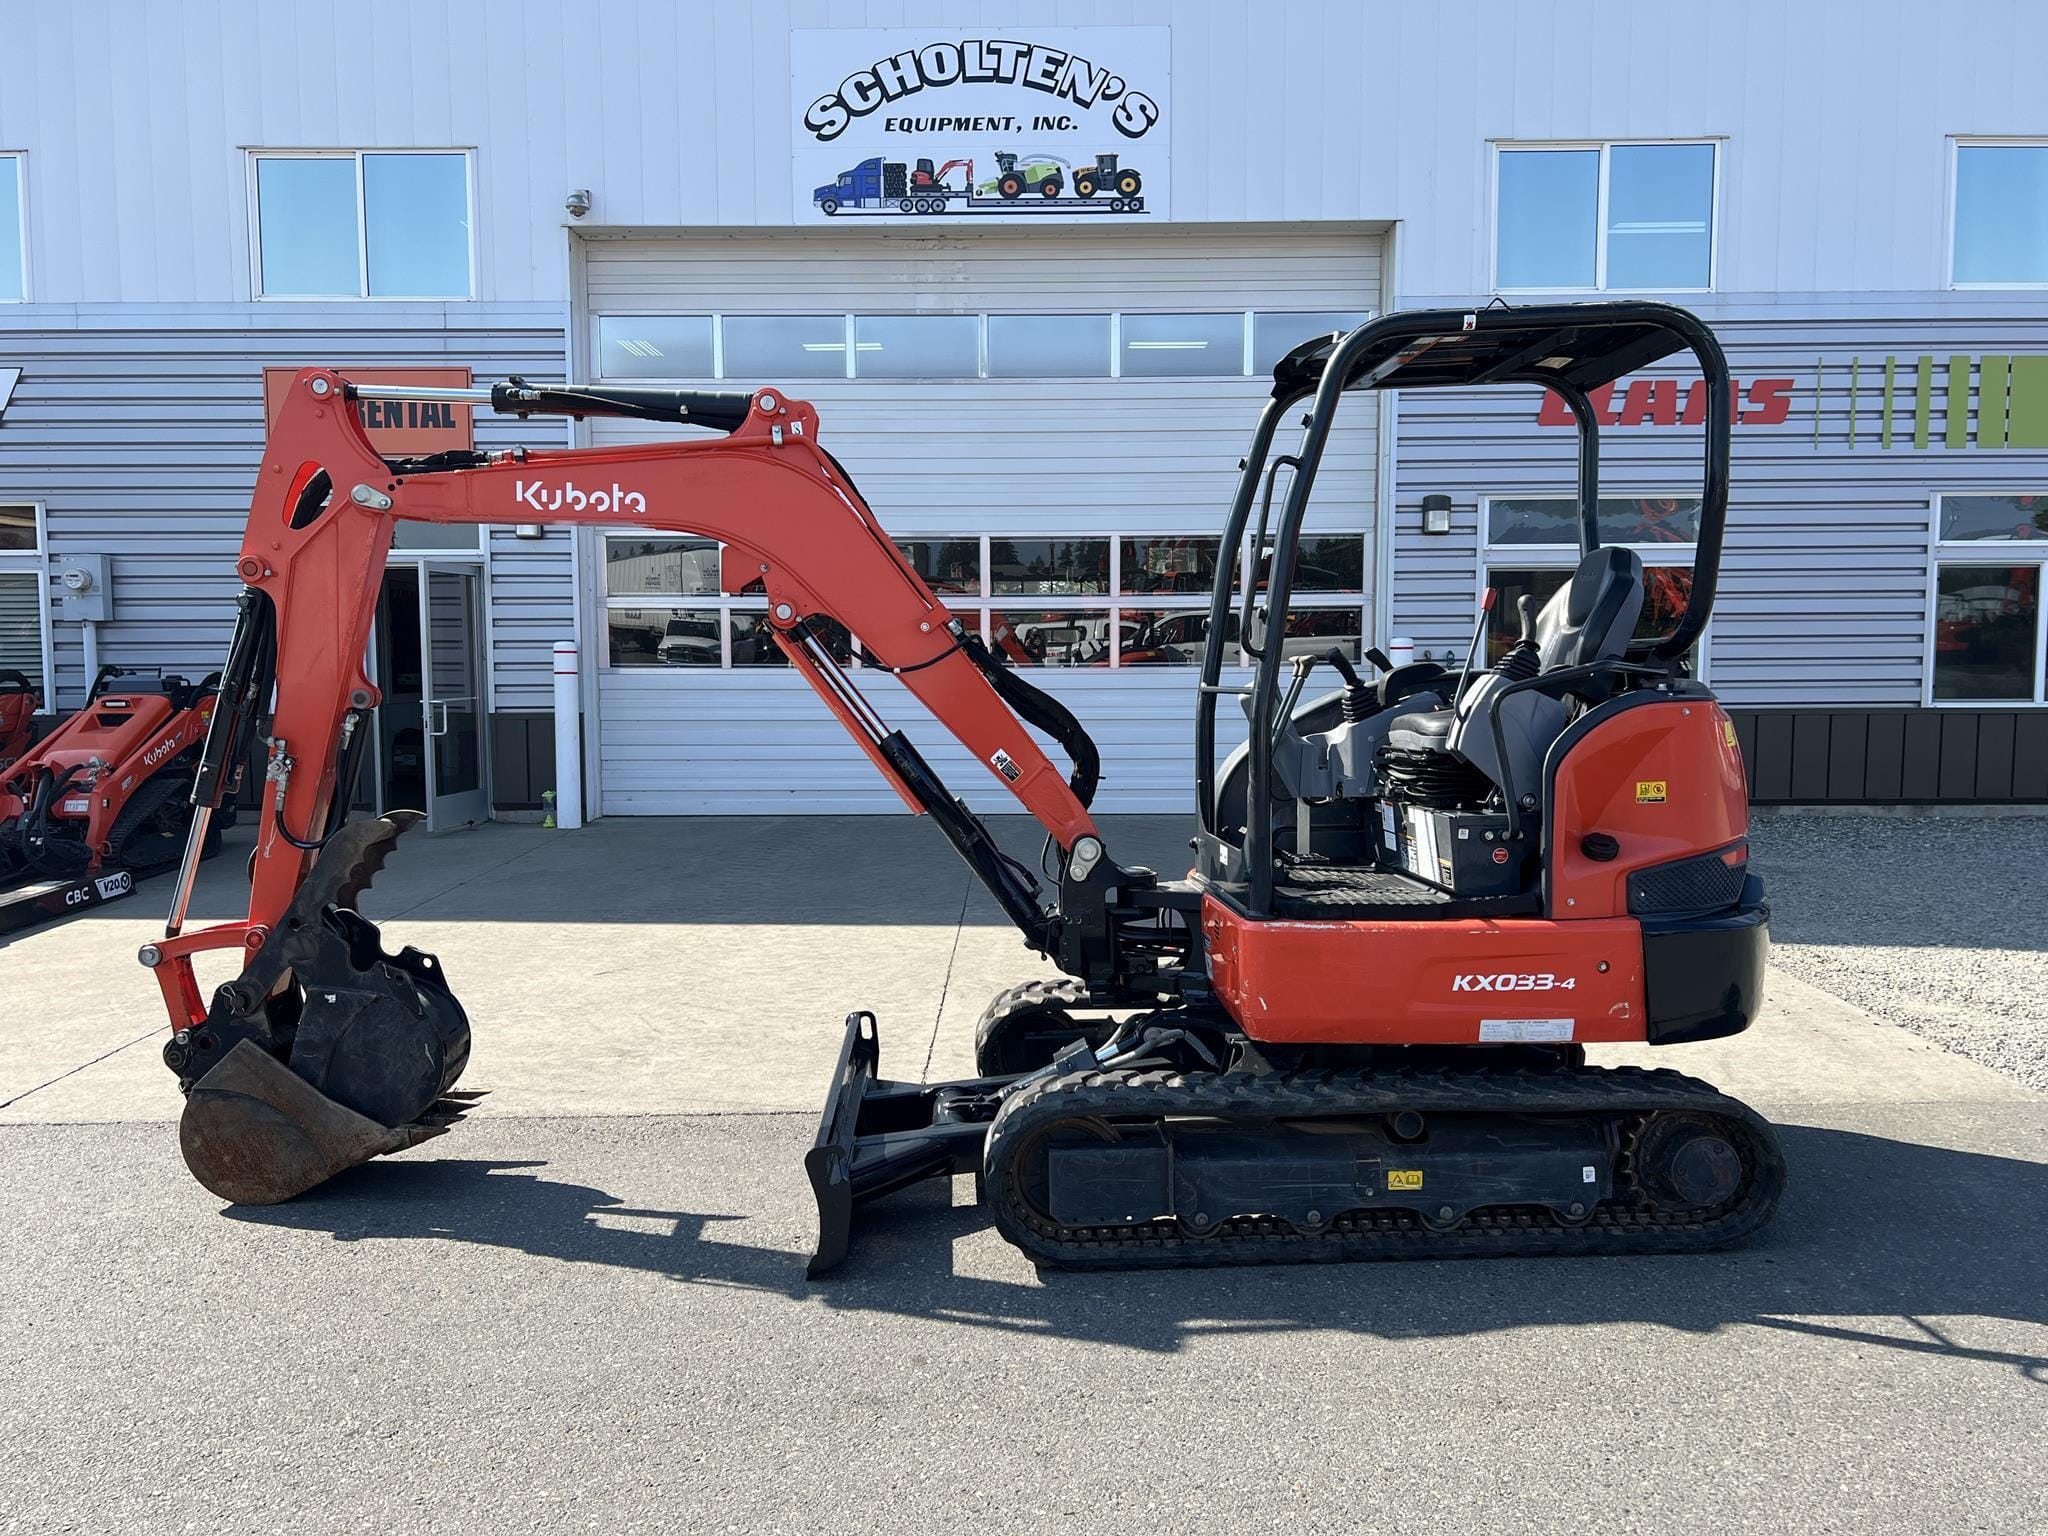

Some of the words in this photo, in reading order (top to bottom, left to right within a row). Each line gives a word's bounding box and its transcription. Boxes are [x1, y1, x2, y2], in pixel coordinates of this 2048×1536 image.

[804, 40, 1159, 141] SCHOLTEN'S
[884, 116, 1023, 133] EQUIPMENT,
[1032, 116, 1079, 131] INC.
[516, 480, 646, 512] Kubota
[143, 739, 175, 765] Kubota
[66, 887, 90, 905] CBC
[1452, 974, 1576, 992] KX033-4
